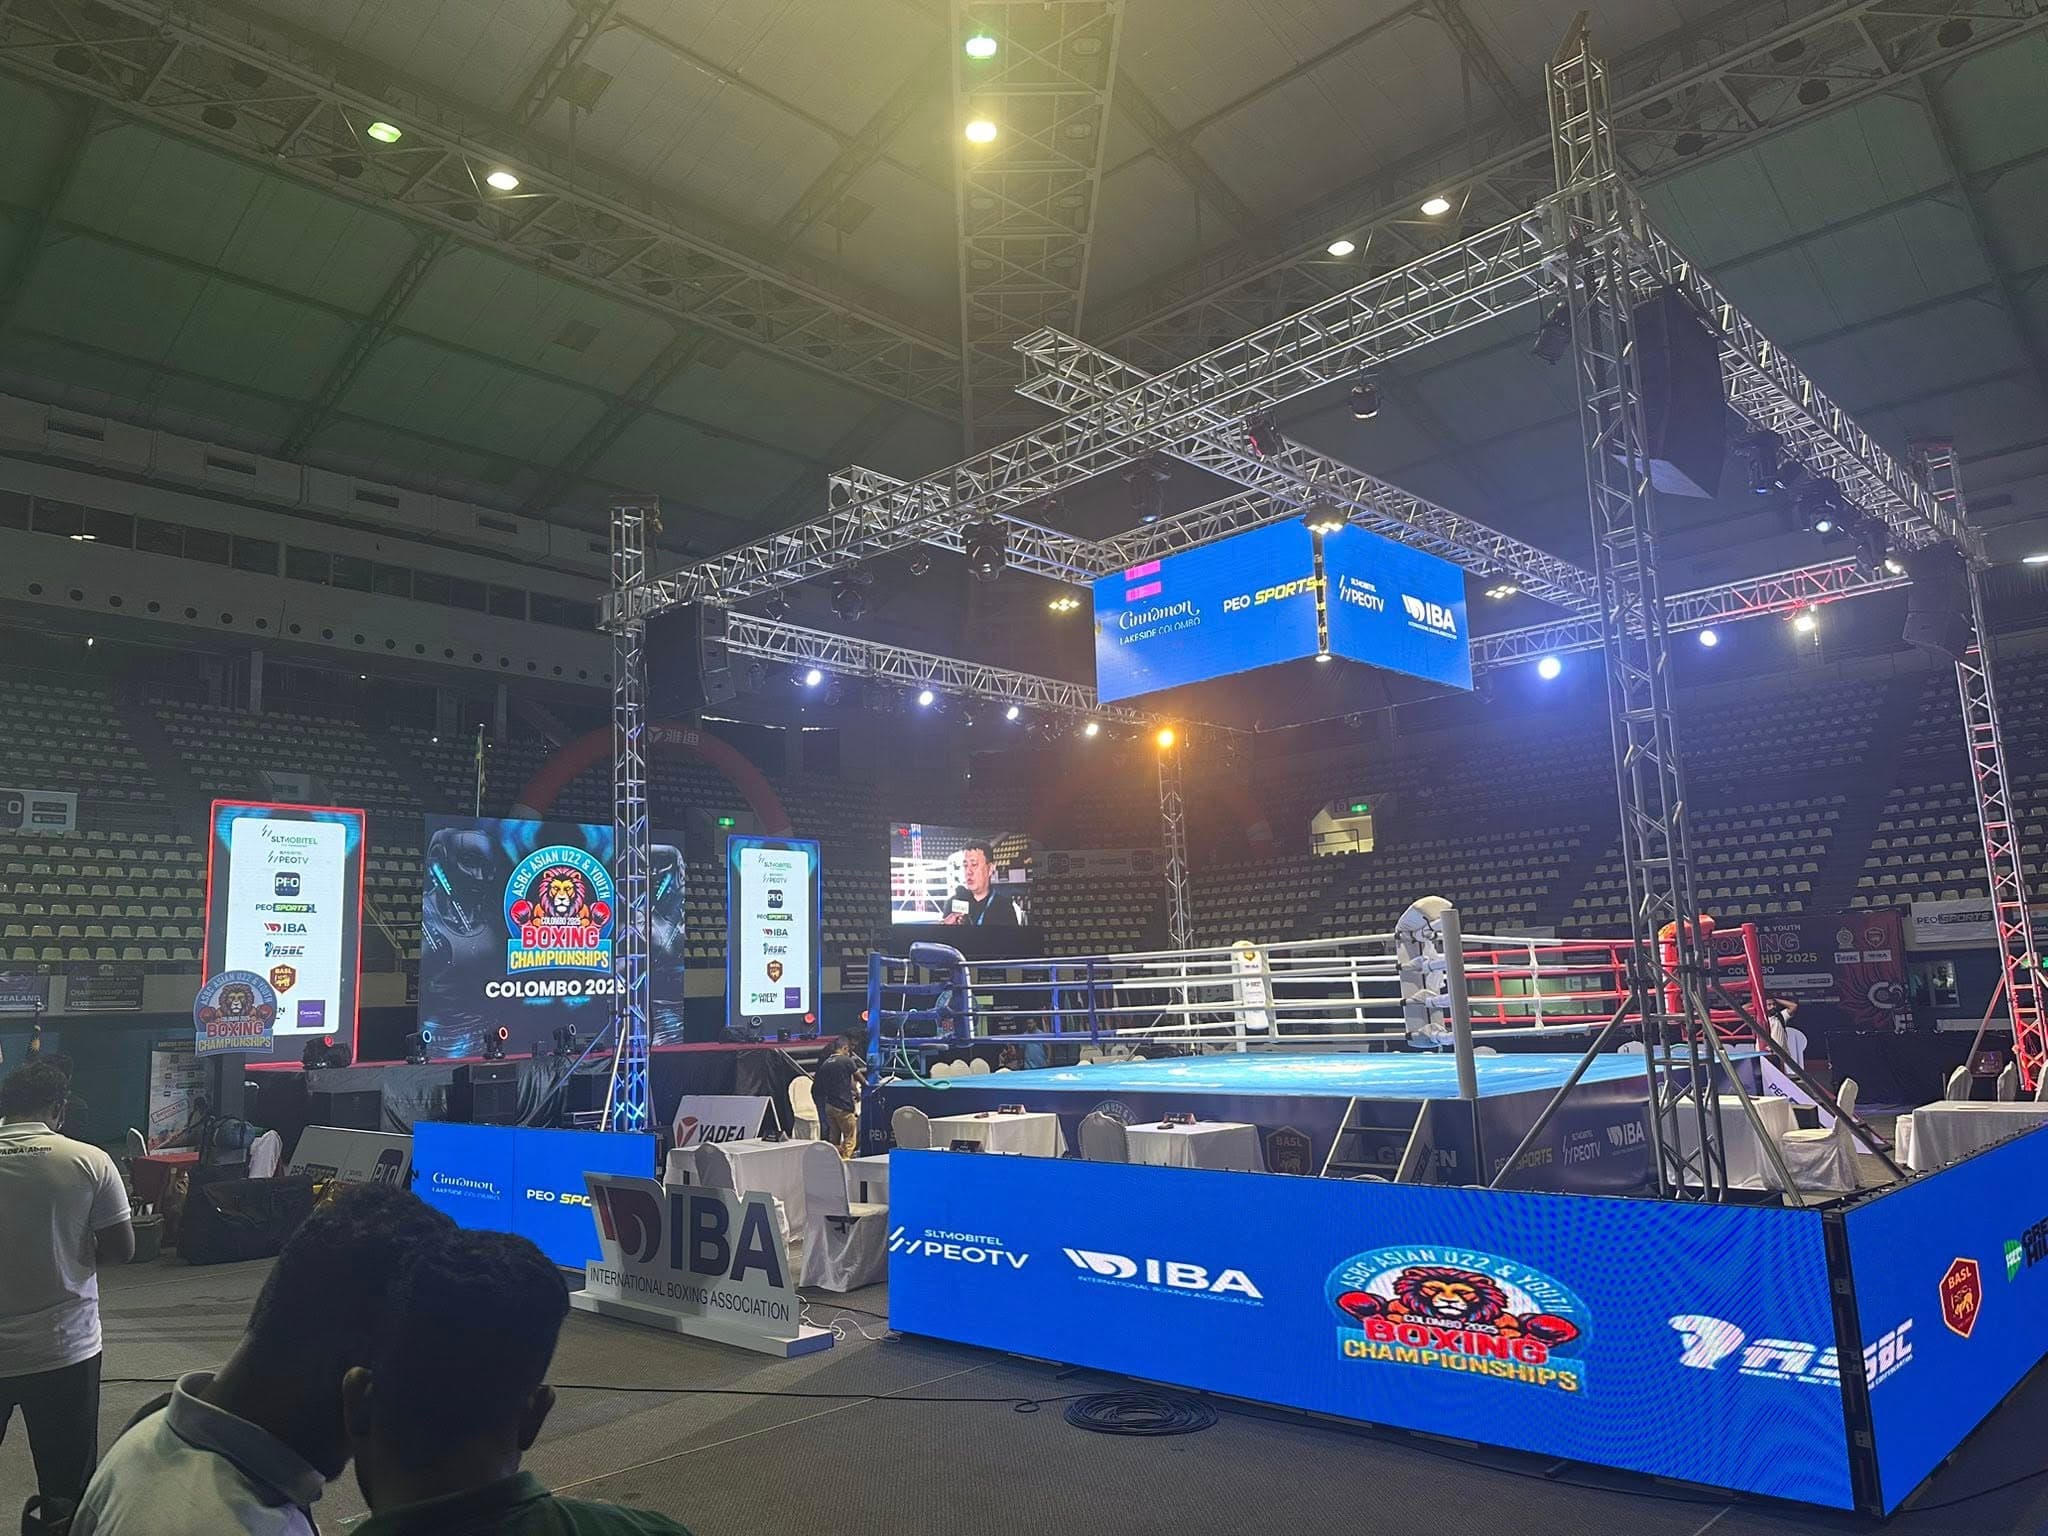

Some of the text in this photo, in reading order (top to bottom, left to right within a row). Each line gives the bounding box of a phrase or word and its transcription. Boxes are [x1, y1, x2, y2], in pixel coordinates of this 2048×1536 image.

[1223, 576, 1317, 613] PEO SPORTS
[1351, 588, 1385, 612] PEOTV
[1119, 600, 1200, 630] Cinnamon
[1425, 602, 1457, 633] IBA
[1119, 617, 1201, 645] LAKESIDE COLOMBO
[271, 836, 319, 845] SLTMOBITEL
[279, 856, 309, 864] PEOTV
[512, 850, 611, 899] ASBC ASIAN U22 & YOUTH
[255, 903, 273, 911] PEO
[275, 903, 308, 912] SPORTS
[1917, 911, 1991, 924] PEO SPORTS
[283, 923, 307, 933] IBA
[522, 927, 600, 949] BOXING
[774, 928, 788, 937] IBA
[1773, 924, 1801, 932] YOUTH
[510, 950, 609, 969] CHAMPIONSHIPS
[1786, 952, 1818, 963] 2025
[485, 980, 582, 998] COLOMBO
[207, 1021, 264, 1038] BOXING
[199, 1036, 271, 1051] CHAMPIONSHIPS
[699, 1125, 746, 1142] YADEA
[1623, 1121, 1646, 1145] IBA
[1573, 1142, 1601, 1163] PEOTV
[432, 1171, 501, 1194] Cinnamon
[526, 1189, 555, 1202] PEO
[669, 1193, 785, 1289] IBA
[924, 1228, 1004, 1246] SLTMOBITEL
[924, 1242, 1030, 1270] PEOTV
[1146, 1258, 1265, 1299] IBA
[1339, 1248, 1575, 1314] ASBC ASIAN U22 & YOUTH
[1948, 1266, 1973, 1290] BASL
[590, 1268, 789, 1322] INTERNATIONAL BOXING ASSOCIATION
[1077, 1275, 1265, 1307] INTERNATIONAL BOXING ASSOCIATION
[1403, 1314, 1499, 1335] COLOMBO 2025
[1362, 1316, 1550, 1366] BOXING
[1342, 1338, 1579, 1393] CHAMPIONSHIPS
